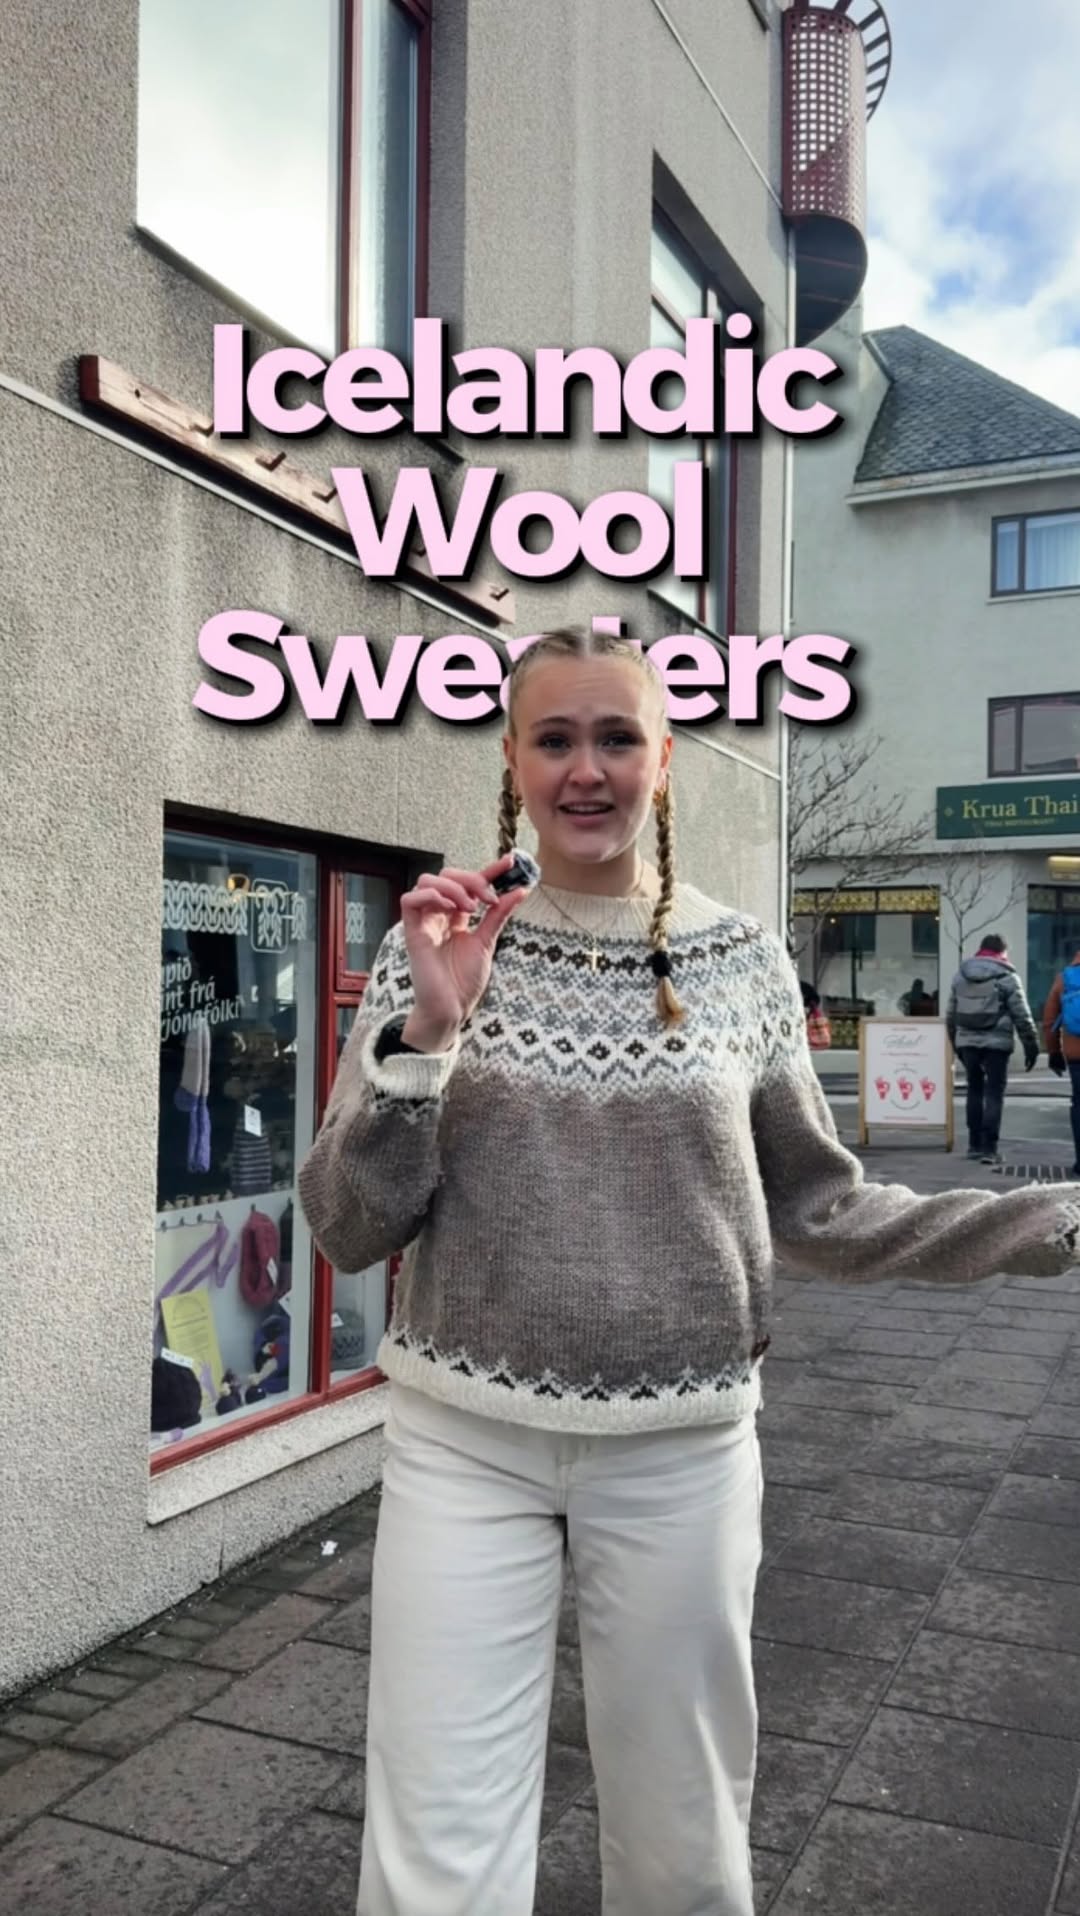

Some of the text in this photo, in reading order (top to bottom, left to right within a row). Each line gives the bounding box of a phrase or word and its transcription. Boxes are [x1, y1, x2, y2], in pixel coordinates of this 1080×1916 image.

[962, 794, 1079, 819] Krua Thai
[190, 975, 215, 1009] frá
